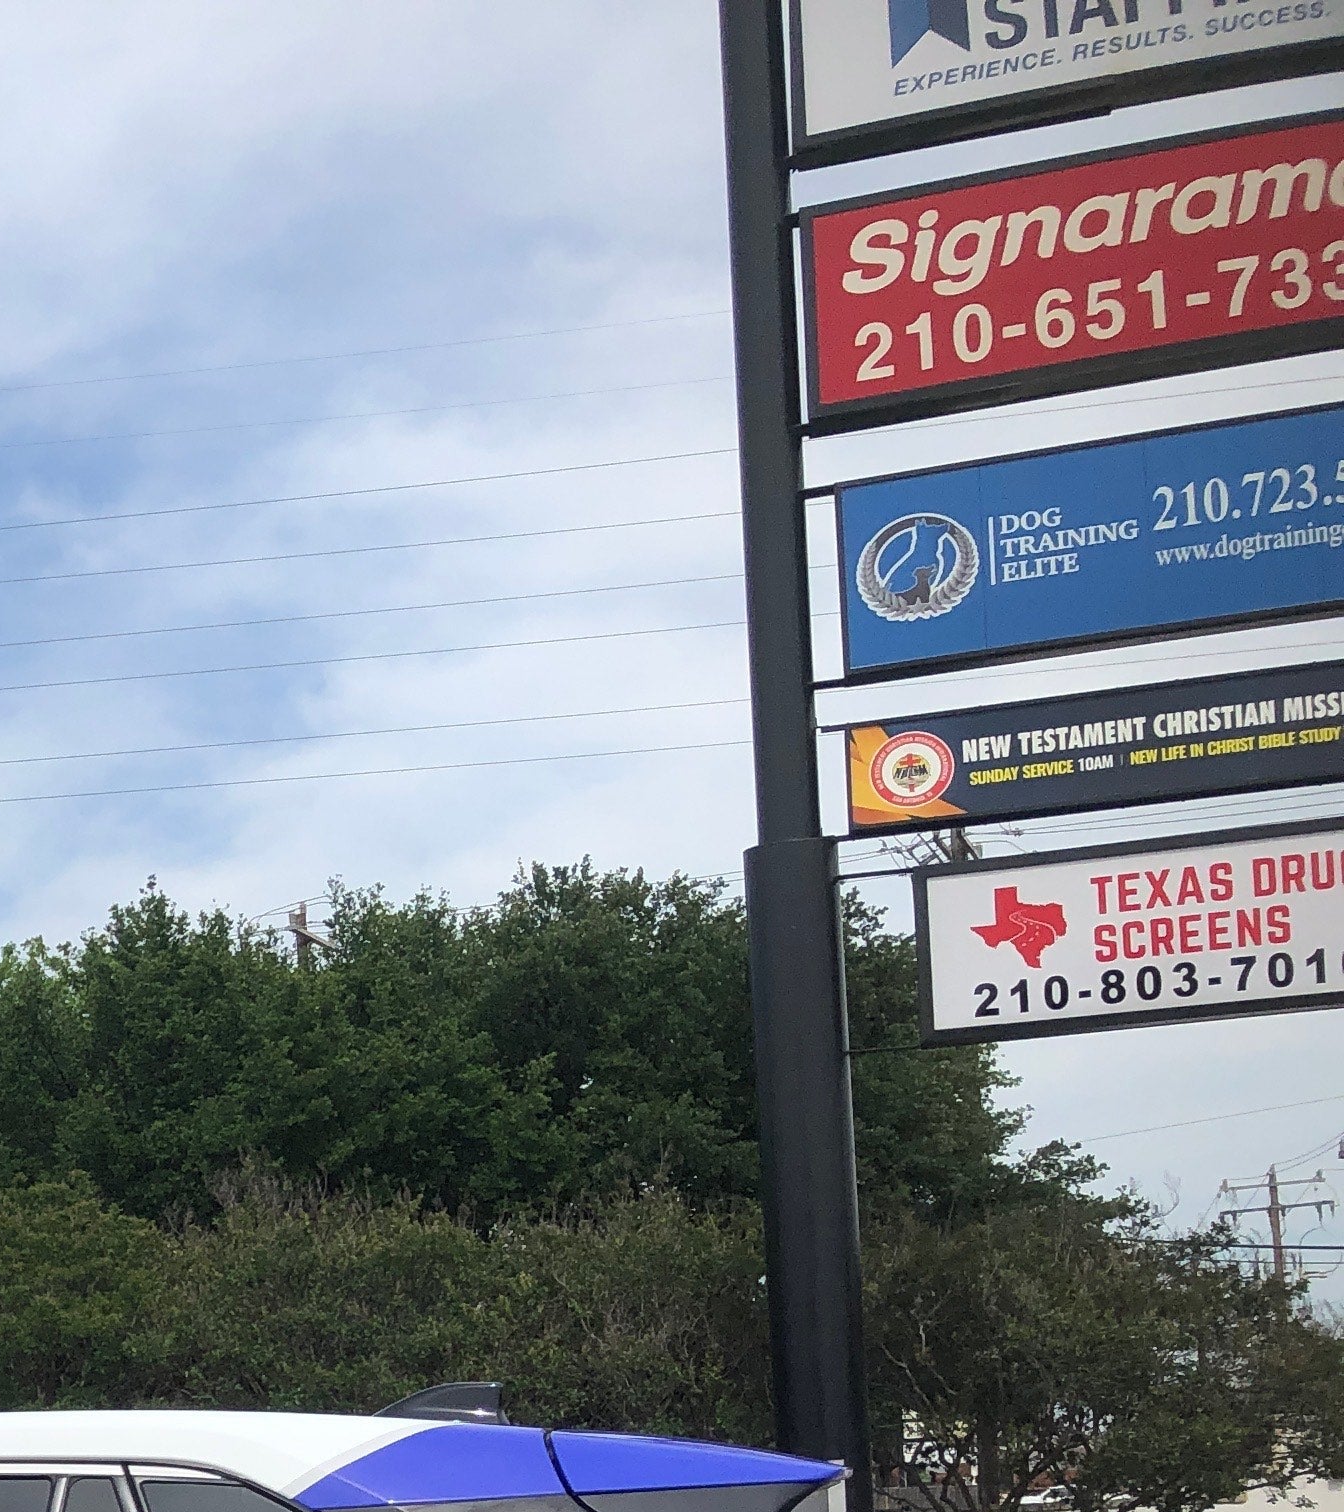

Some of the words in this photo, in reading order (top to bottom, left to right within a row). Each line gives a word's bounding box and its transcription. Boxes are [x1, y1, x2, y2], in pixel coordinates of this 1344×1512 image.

[893, 50, 1063, 97] EXPERIENCE.
[1072, 24, 1194, 63] RESULTS.
[1205, 2, 1332, 36] SUCCESS.
[841, 158, 1344, 297] Signaram
[1000, 506, 1063, 534] DOG
[1002, 518, 1140, 559] TRAINING
[1155, 521, 1344, 566] www.dogtraining
[1002, 552, 1081, 584] ELITE
[962, 735, 1011, 763] NEW
[1018, 717, 1146, 755] TESTAMENT
[1153, 700, 1276, 739] CHRISTIAN
[969, 767, 1019, 786] SUNDAY
[1022, 760, 1074, 780] SERVICE
[1078, 755, 1114, 772] 10AM
[1129, 749, 1157, 766] NEW
[1162, 745, 1187, 762] LIFE
[1190, 743, 1204, 759] IN
[1208, 737, 1255, 756] CHRIST
[1259, 732, 1296, 750] BIBLE
[1299, 726, 1342, 745] STUDY
[1091, 862, 1234, 915] TEXAS
[1252, 850, 1344, 898] DRU
[1093, 904, 1292, 963] SCREENS
[974, 948, 1344, 1018] 210-803-701
